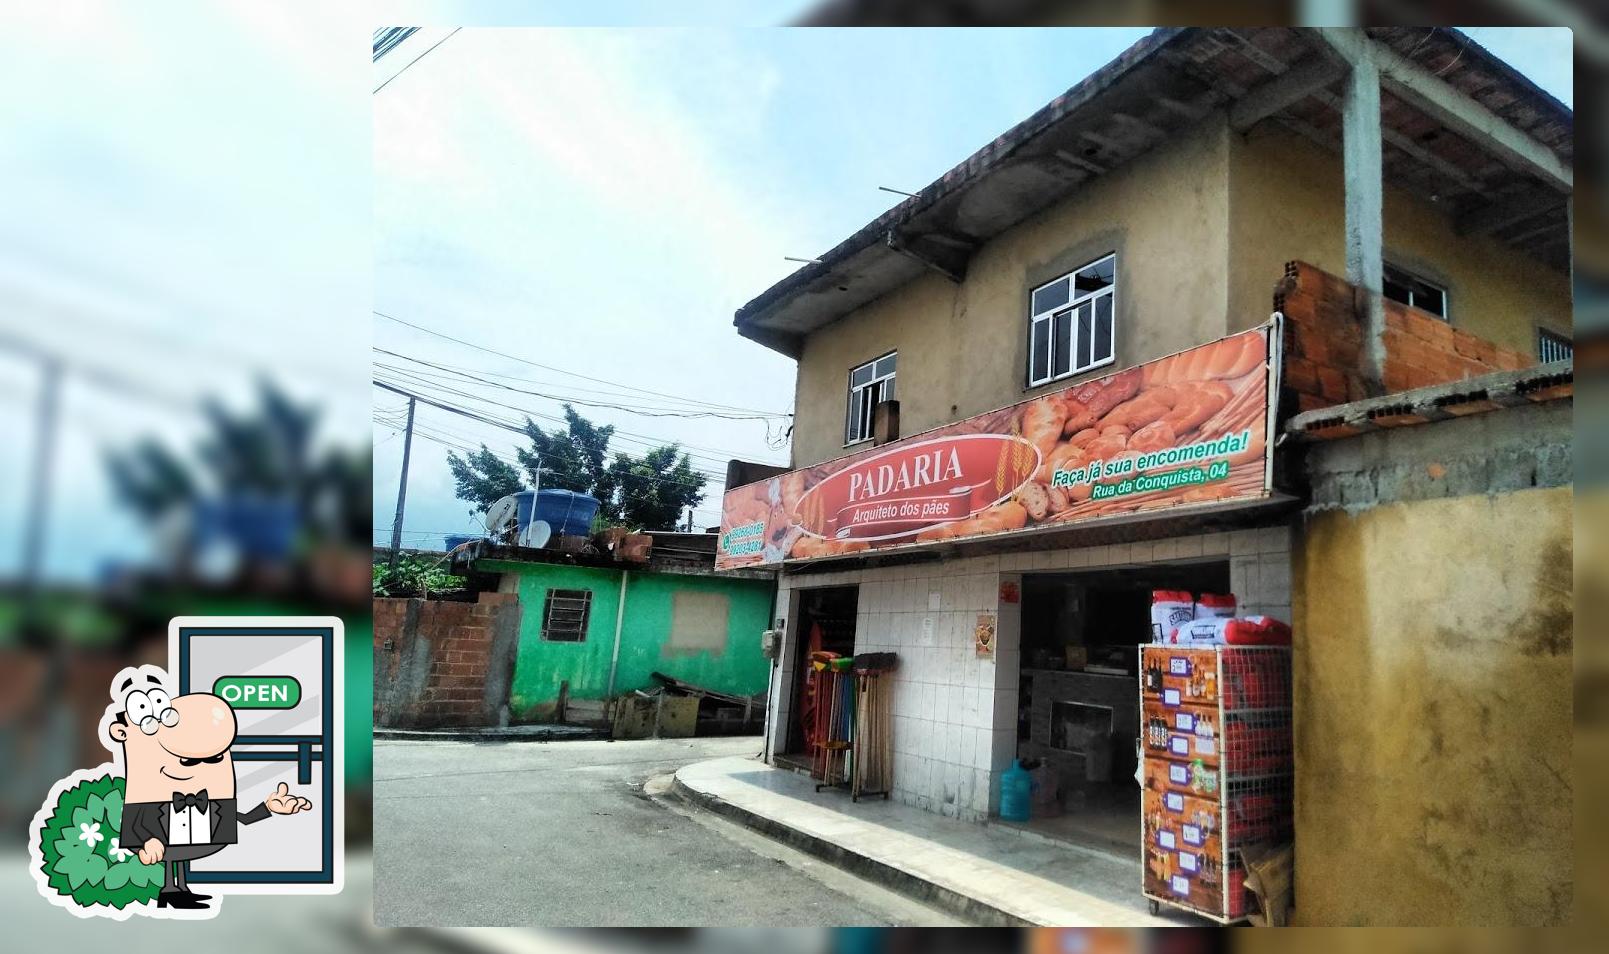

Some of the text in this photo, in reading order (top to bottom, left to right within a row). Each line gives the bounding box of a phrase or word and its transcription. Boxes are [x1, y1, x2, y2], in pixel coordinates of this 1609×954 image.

[848, 446, 963, 502] PADARIA
[1052, 432, 1248, 486] Faça já sua encomenda!
[1093, 463, 1228, 498] Rua da Conquista, 04
[853, 500, 950, 523] Arquiteto dos pães
